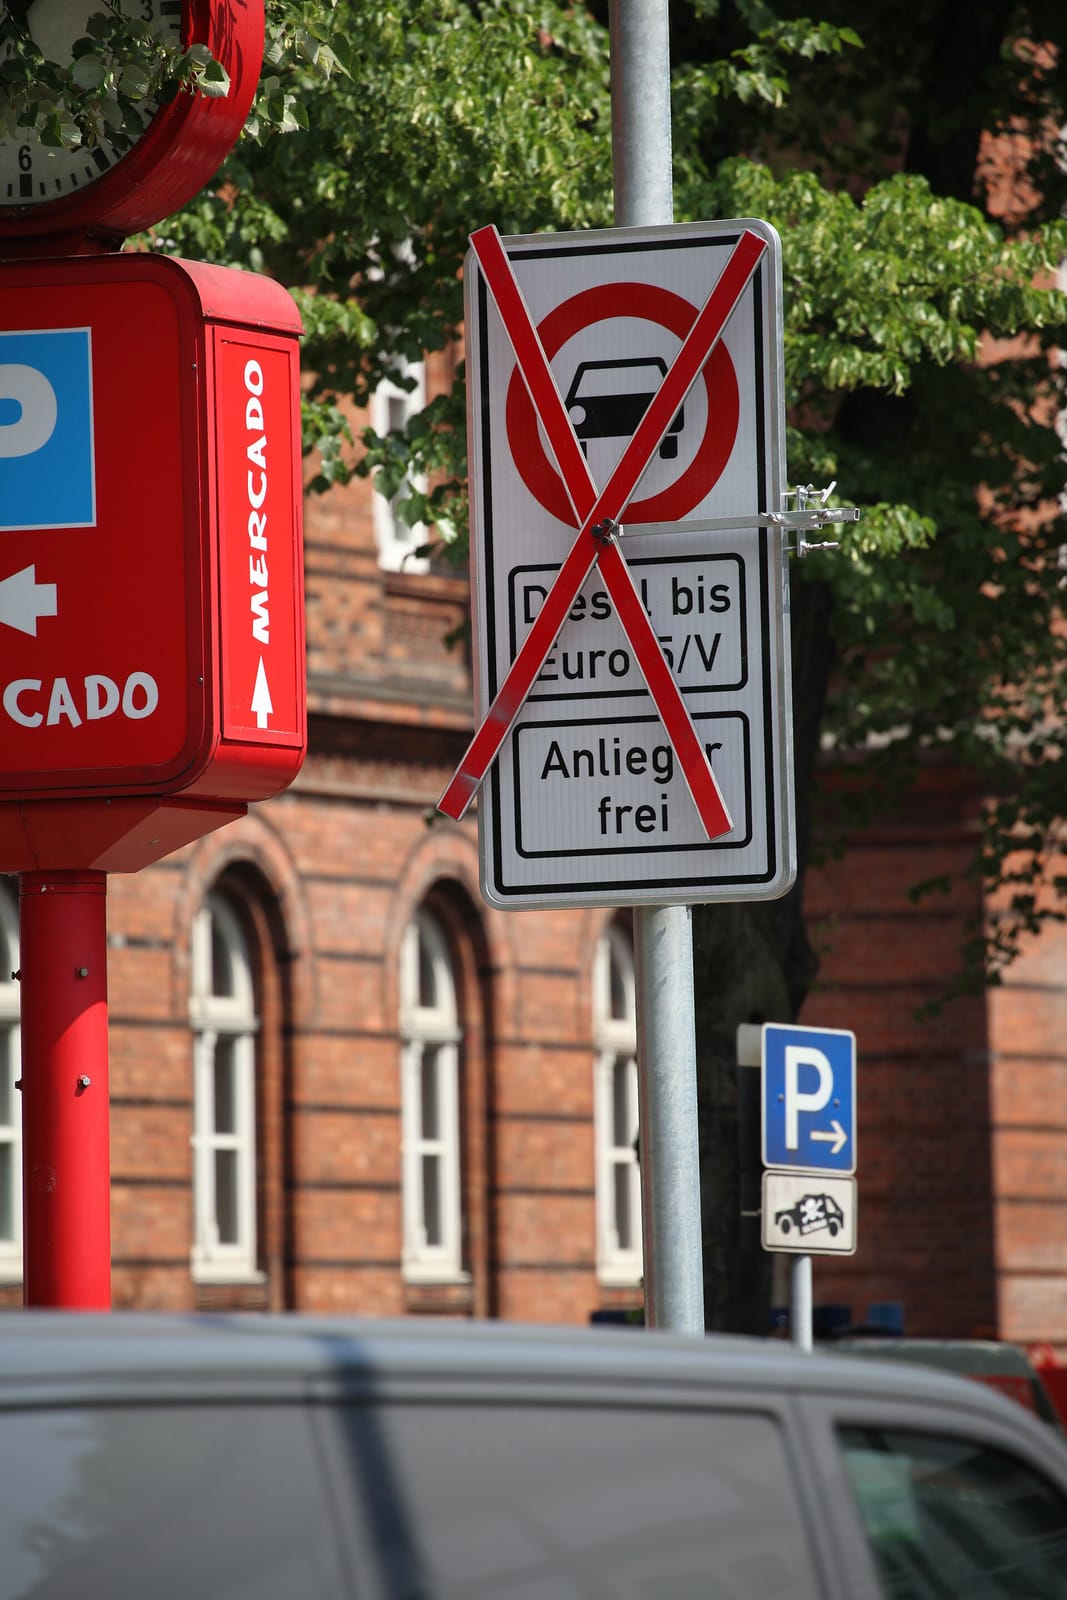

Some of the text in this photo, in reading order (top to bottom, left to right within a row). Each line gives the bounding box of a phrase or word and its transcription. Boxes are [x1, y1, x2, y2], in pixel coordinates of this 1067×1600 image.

[140, 0, 154, 22] 3
[18, 145, 33, 171] 6
[244, 359, 270, 645] MERCADO
[523, 575, 731, 624] Desl bis
[3, 671, 159, 728] CADO
[541, 737, 723, 785] Anliegr
[598, 793, 669, 835] frei
[785, 1045, 834, 1150] P
